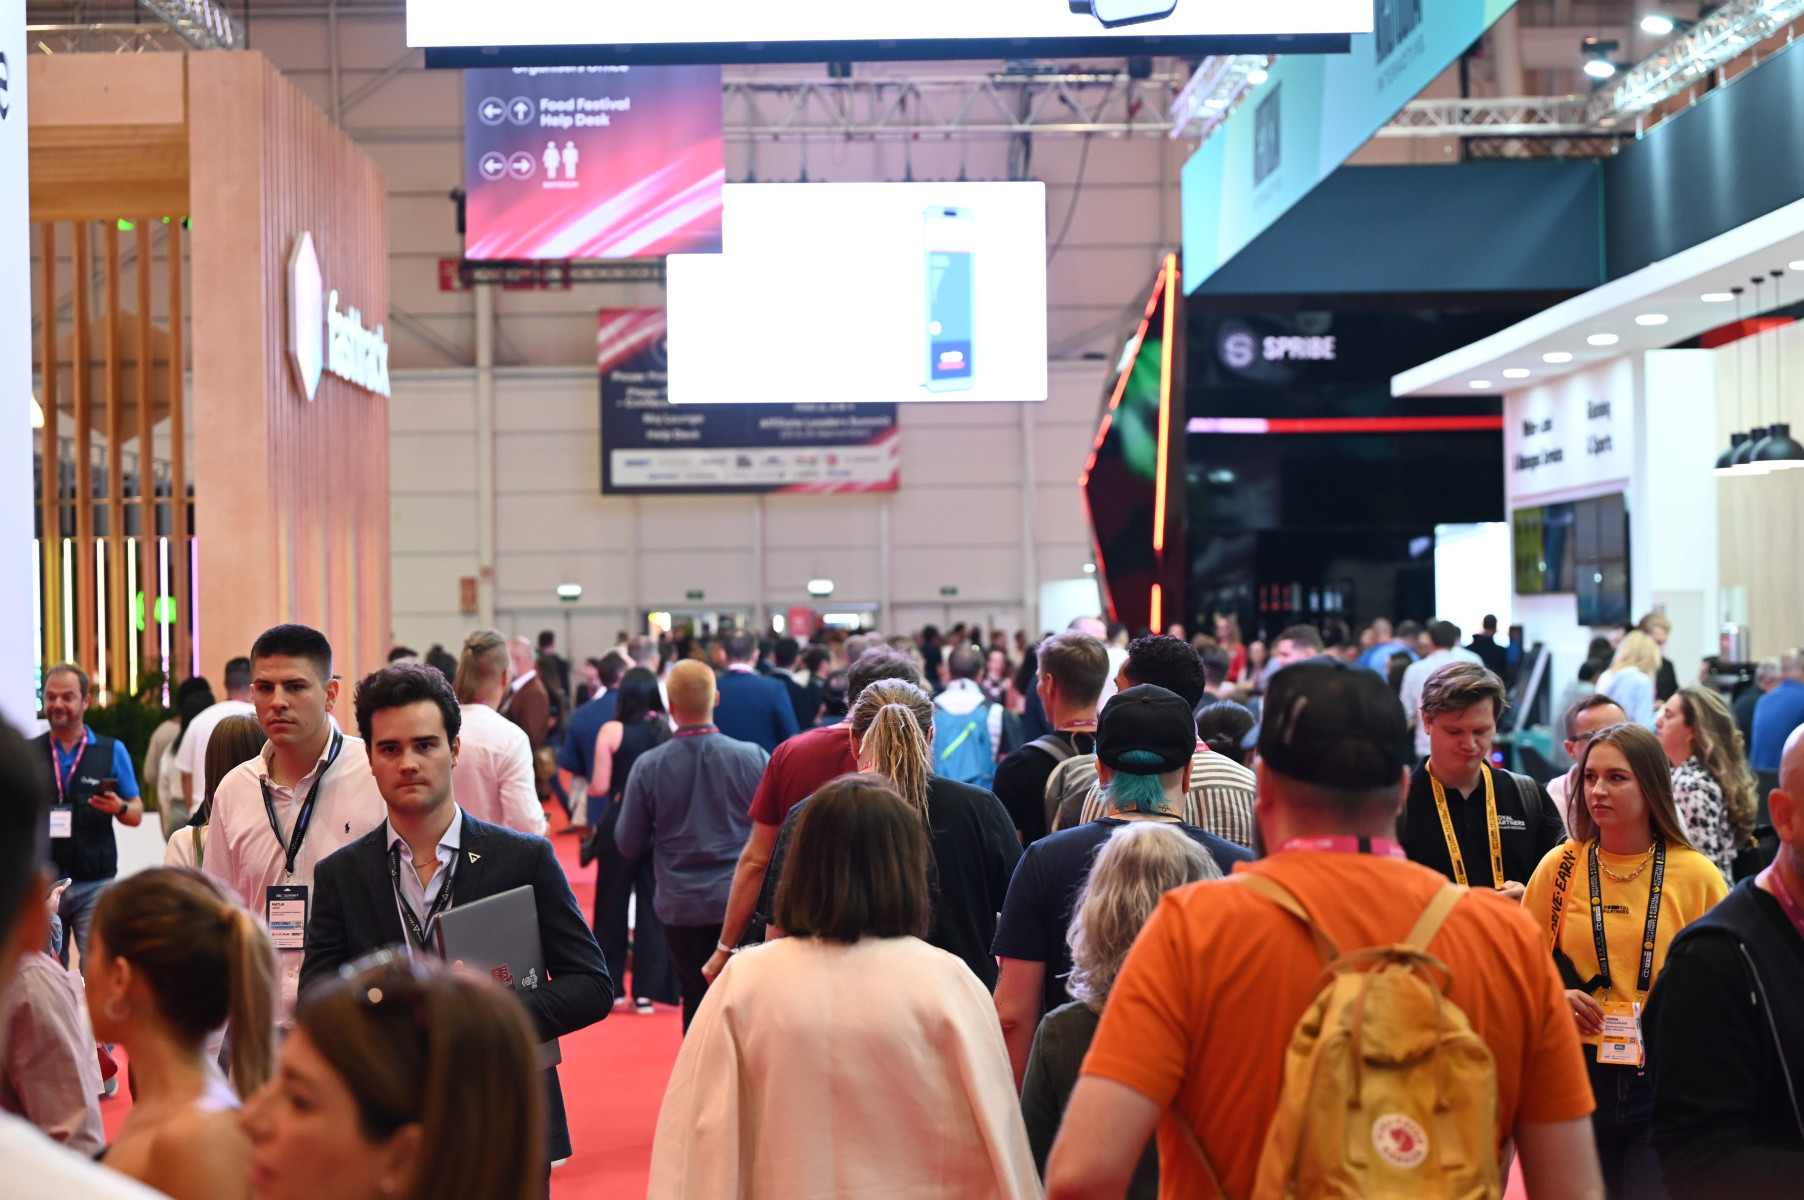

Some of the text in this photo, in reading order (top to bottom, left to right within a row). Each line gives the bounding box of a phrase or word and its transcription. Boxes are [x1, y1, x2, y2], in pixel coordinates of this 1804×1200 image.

[540, 96, 630, 112] Food Festival
[540, 112, 611, 129] Help Desk
[1262, 335, 1337, 360] SPRIBE
